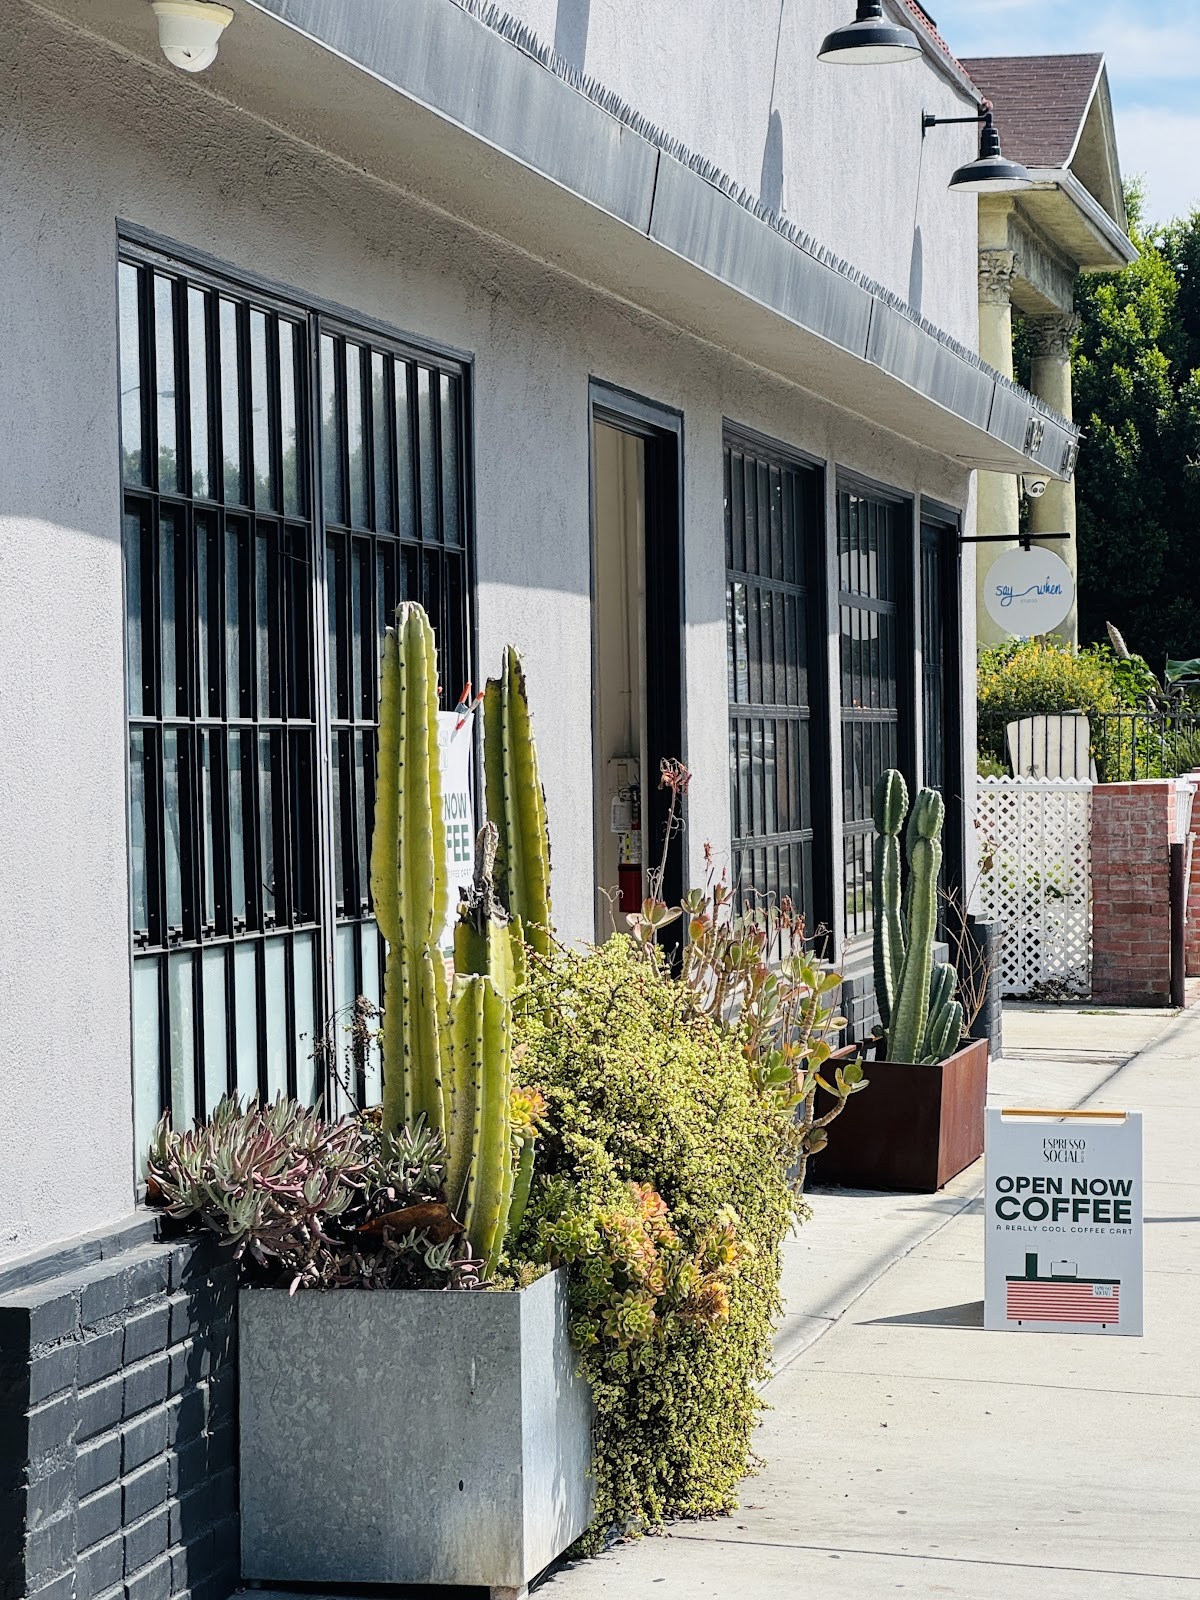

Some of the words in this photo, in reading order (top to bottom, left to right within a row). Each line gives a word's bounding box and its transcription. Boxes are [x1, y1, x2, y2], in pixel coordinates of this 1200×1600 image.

[995, 584, 1013, 607] say
[1036, 575, 1062, 595] when
[444, 792, 467, 820] NOW
[446, 824, 470, 862] FEE
[1043, 1138, 1086, 1150] ESPRESSO
[1043, 1149, 1081, 1163] SOCIAL
[995, 1175, 1063, 1195] OPEN
[1071, 1178, 1133, 1197] NOW
[995, 1195, 1132, 1225] COFFEE
[1070, 1226, 1105, 1234] COFFEE
